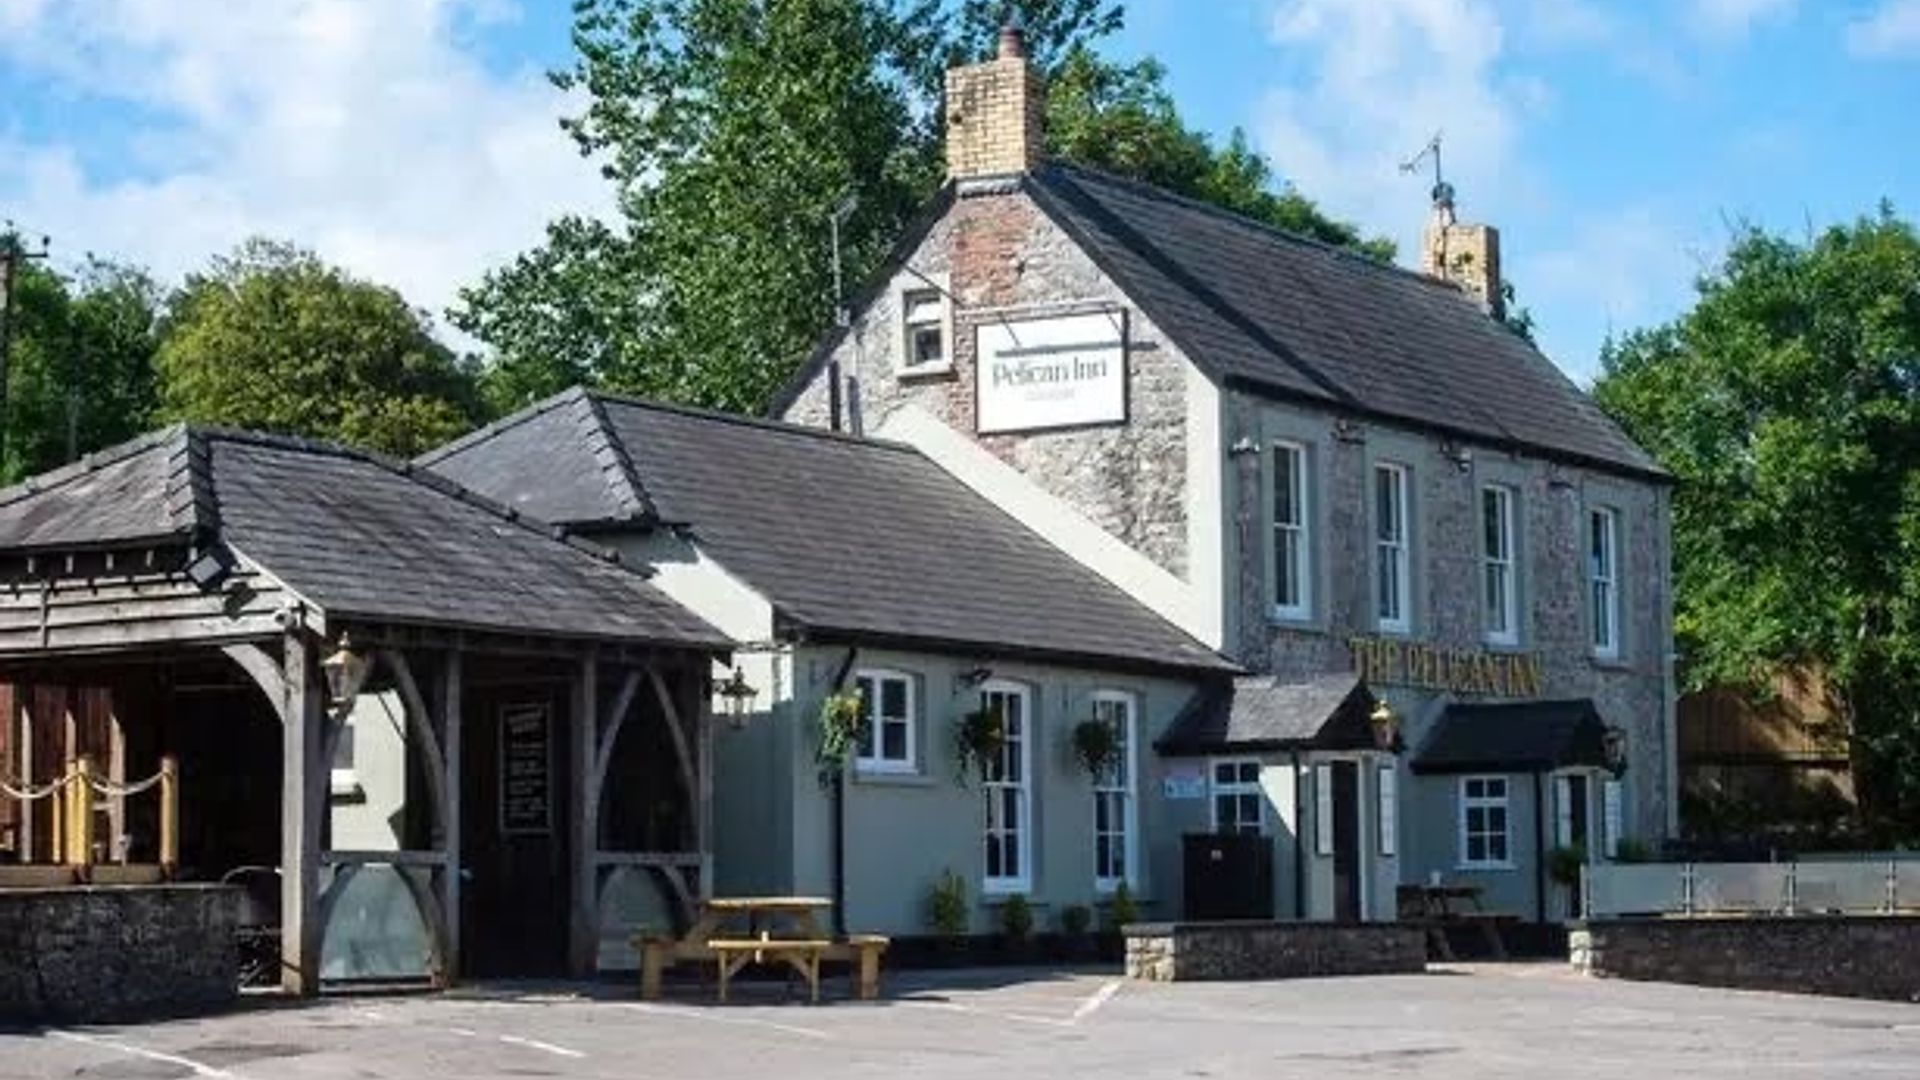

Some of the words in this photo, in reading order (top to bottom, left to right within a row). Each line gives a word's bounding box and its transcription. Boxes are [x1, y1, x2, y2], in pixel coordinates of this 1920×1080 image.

[993, 360, 1069, 387] Pelican
[1074, 356, 1107, 380] Inn
[1349, 637, 1401, 683] THE
[1407, 643, 1501, 693] PELICAN
[1507, 650, 1544, 696] INN
